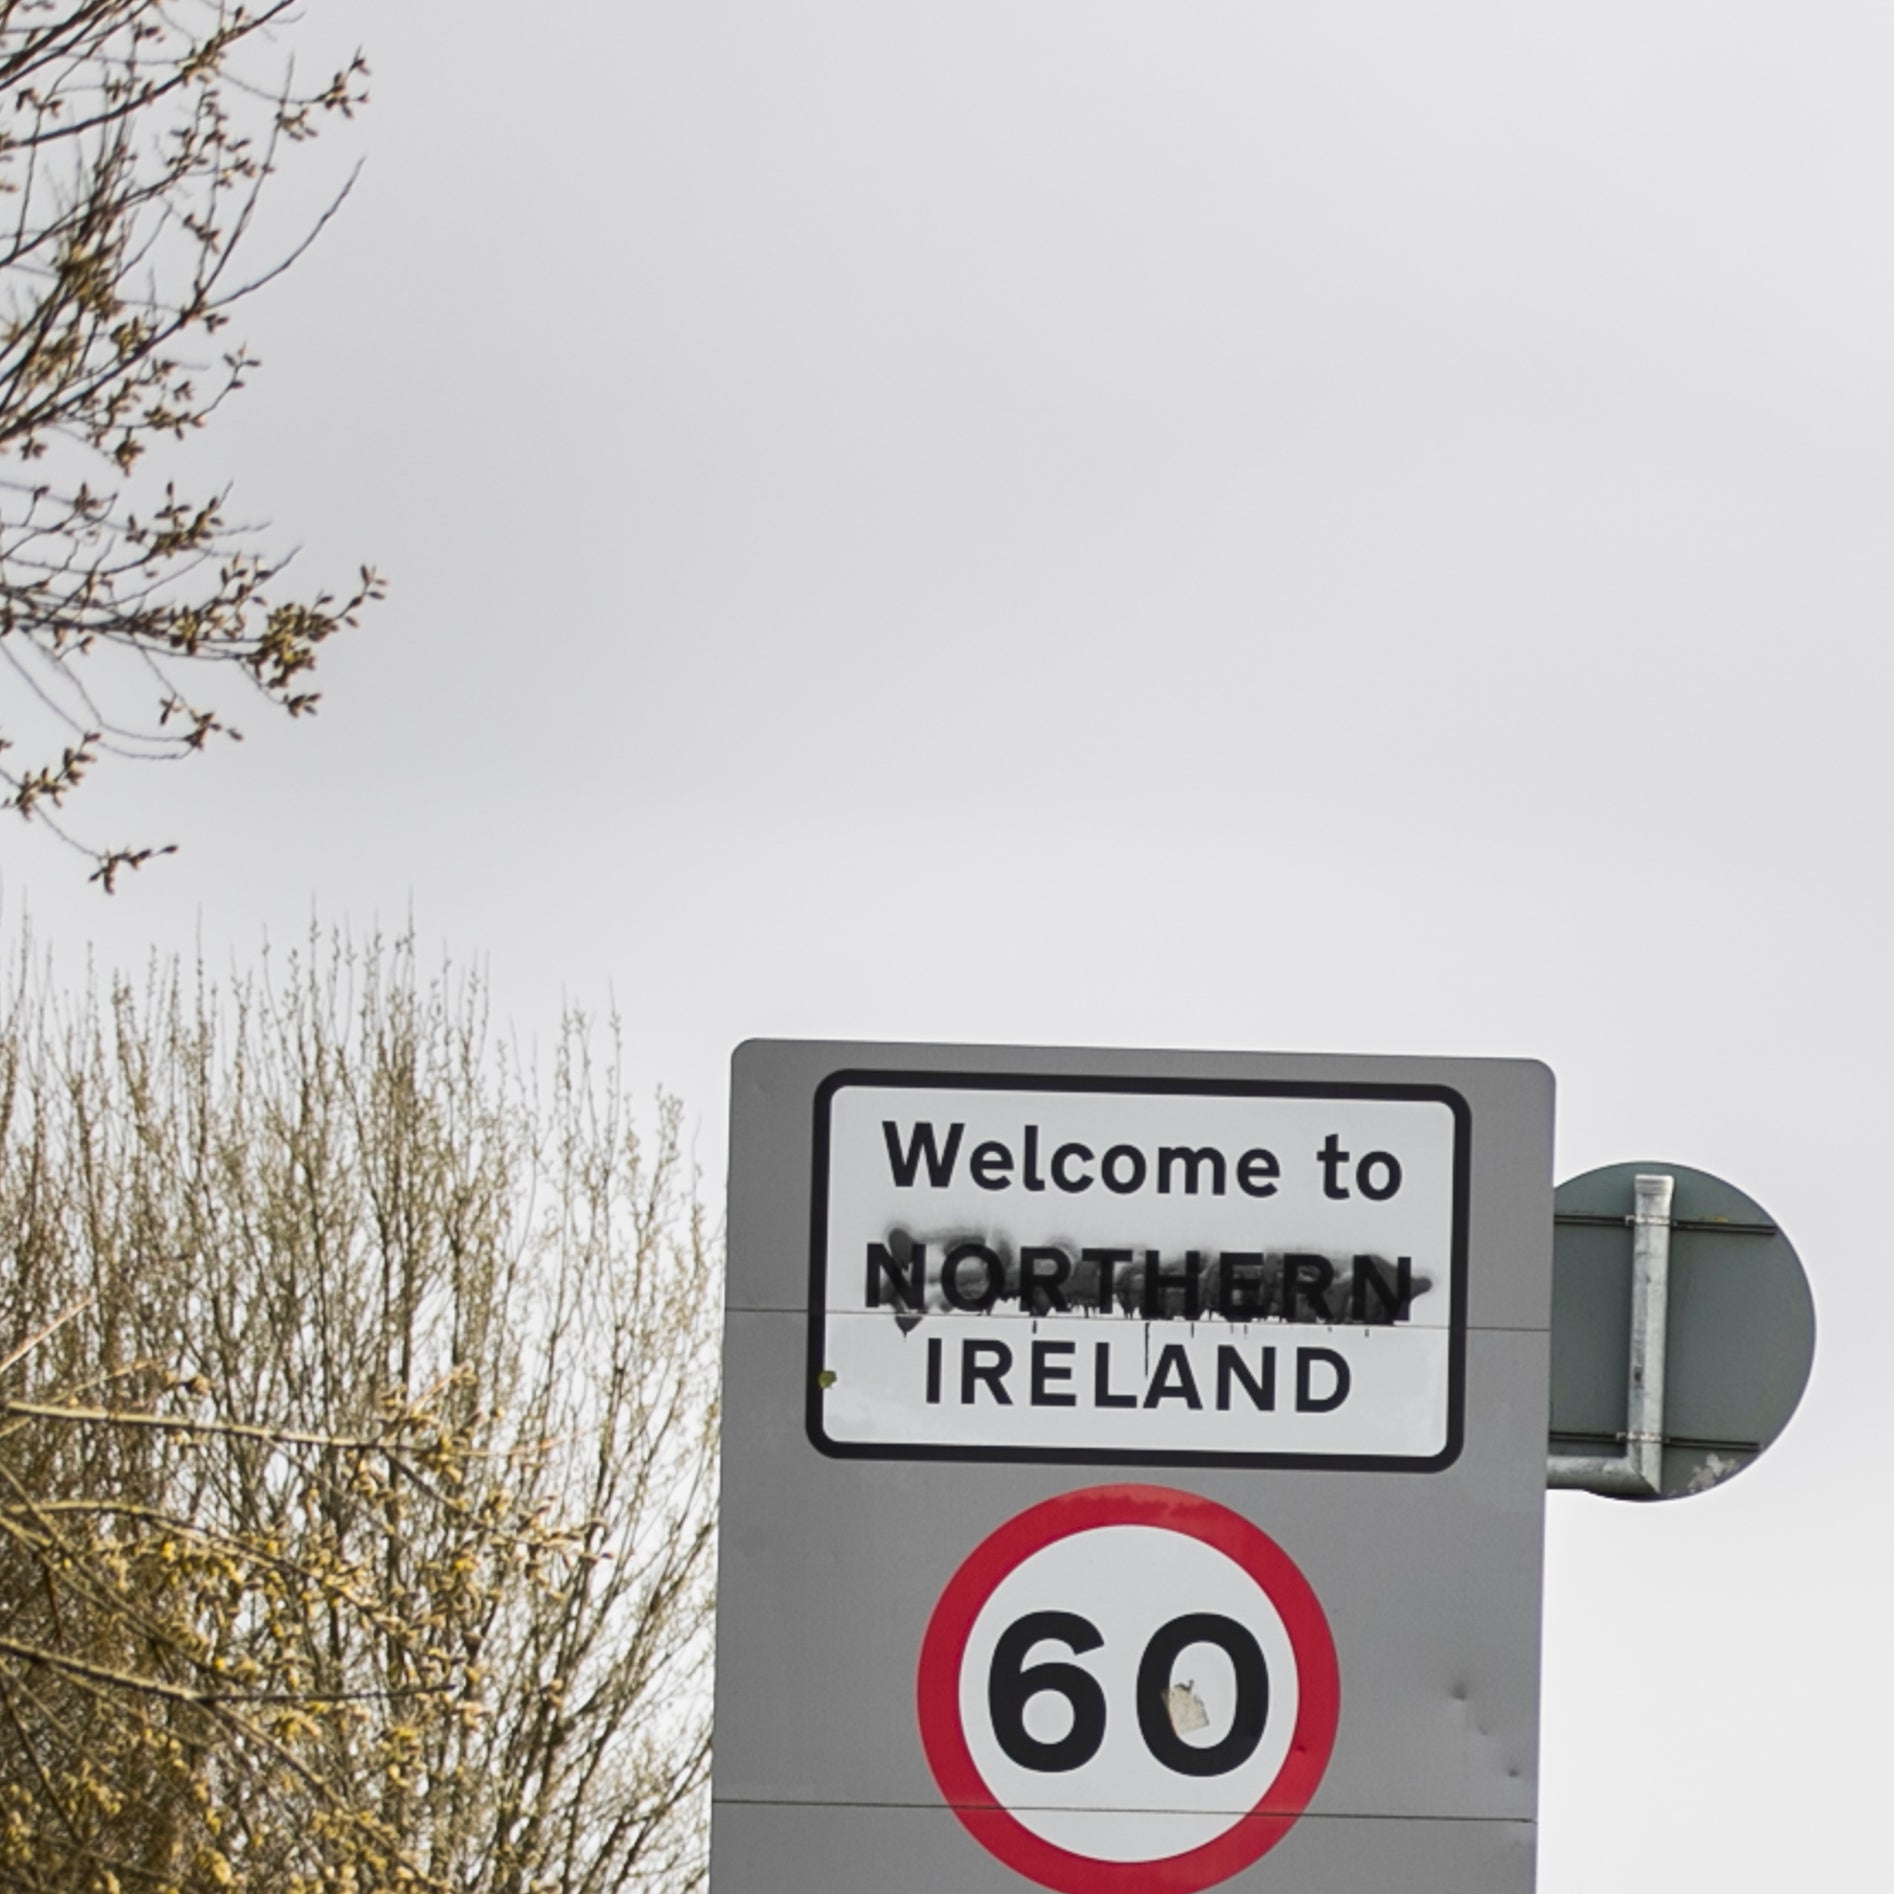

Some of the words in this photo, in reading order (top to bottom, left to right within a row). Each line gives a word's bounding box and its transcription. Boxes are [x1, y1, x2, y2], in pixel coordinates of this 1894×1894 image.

[881, 1120, 1280, 1198] Welcome
[1316, 1133, 1402, 1201] to
[863, 1243, 1413, 1325] NORTHERN
[924, 1338, 1350, 1413] IRELAND
[986, 1609, 1270, 1778] 60
